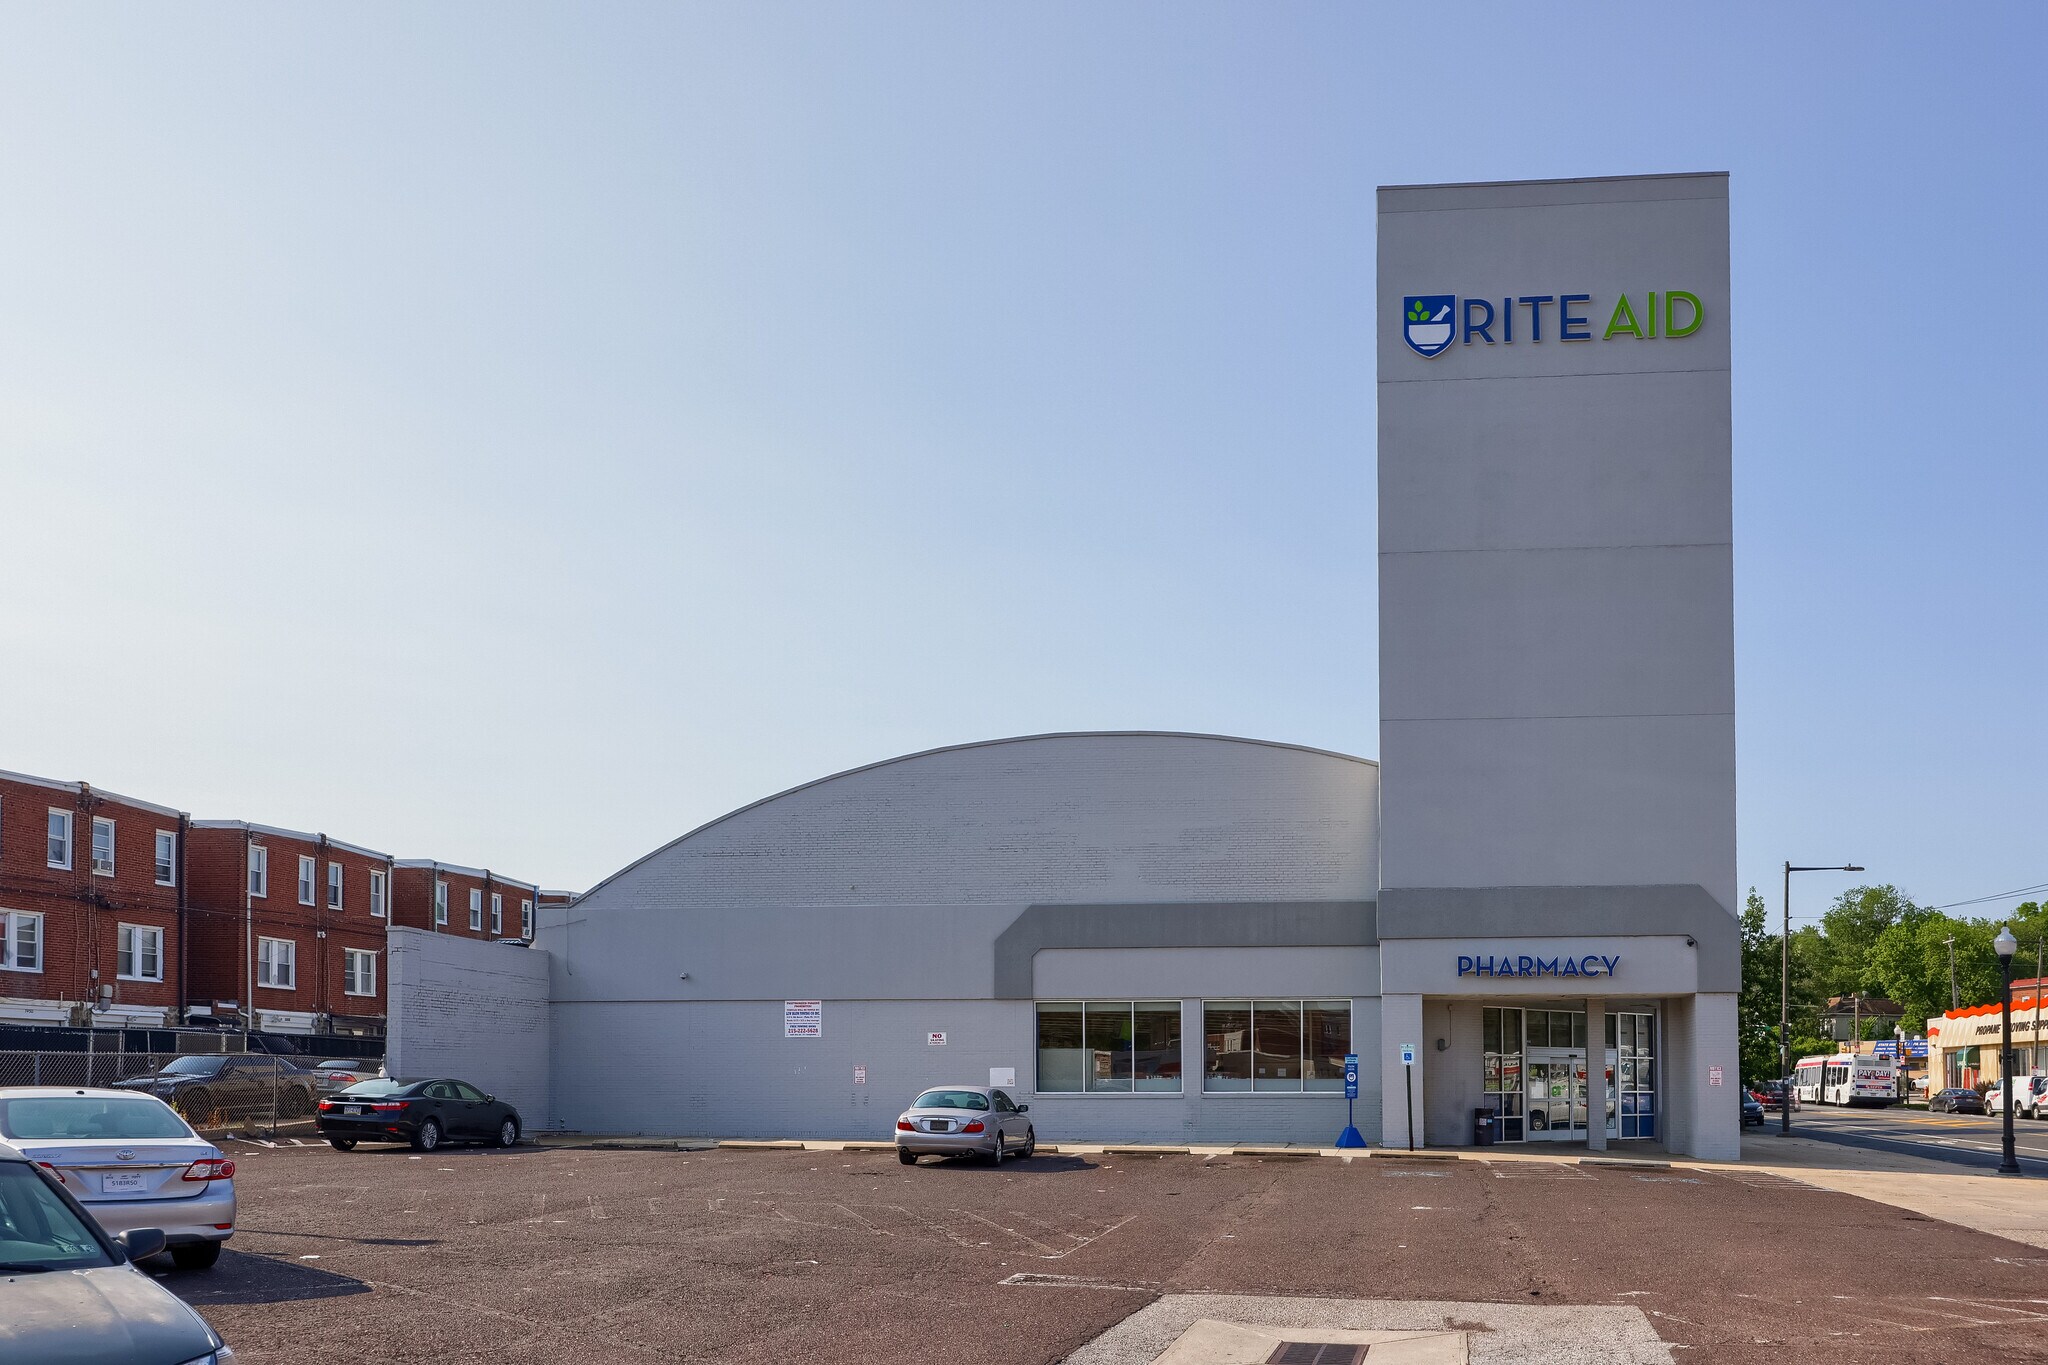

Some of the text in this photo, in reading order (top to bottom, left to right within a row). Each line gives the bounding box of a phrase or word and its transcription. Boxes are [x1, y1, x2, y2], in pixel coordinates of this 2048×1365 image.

[1463, 290, 1705, 345] RITE AID
[1457, 955, 1621, 977] PHARMACY
[1975, 1024, 2001, 1035] PROPANE
[2010, 1021, 2030, 1032] OVING
